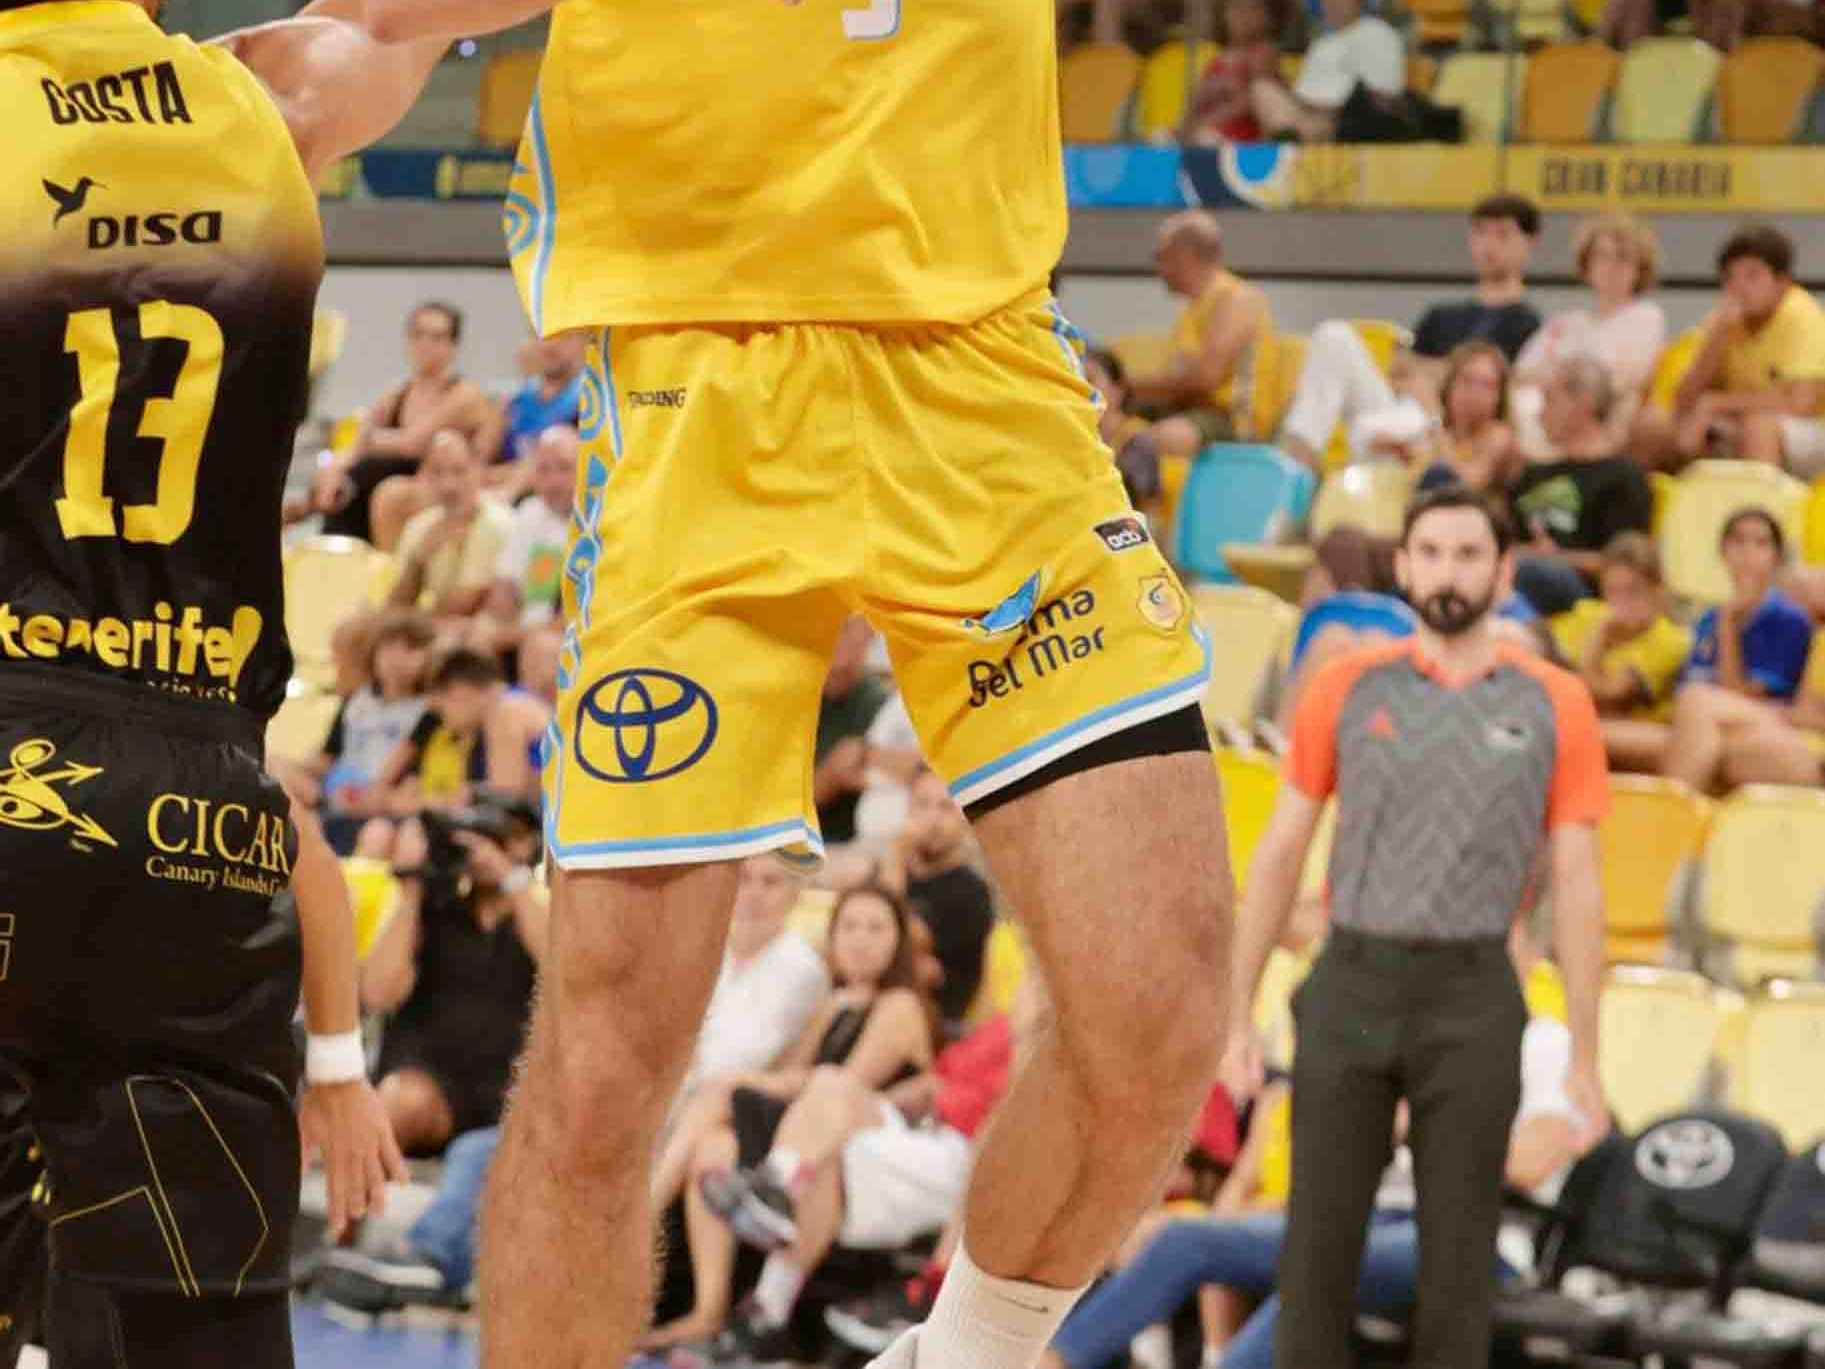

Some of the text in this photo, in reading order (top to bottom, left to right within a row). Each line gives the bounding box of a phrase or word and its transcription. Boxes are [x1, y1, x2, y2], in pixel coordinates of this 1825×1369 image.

[40, 60, 193, 126] COSTA
[55, 298, 225, 545] 13
[146, 792, 290, 876] CICAR
